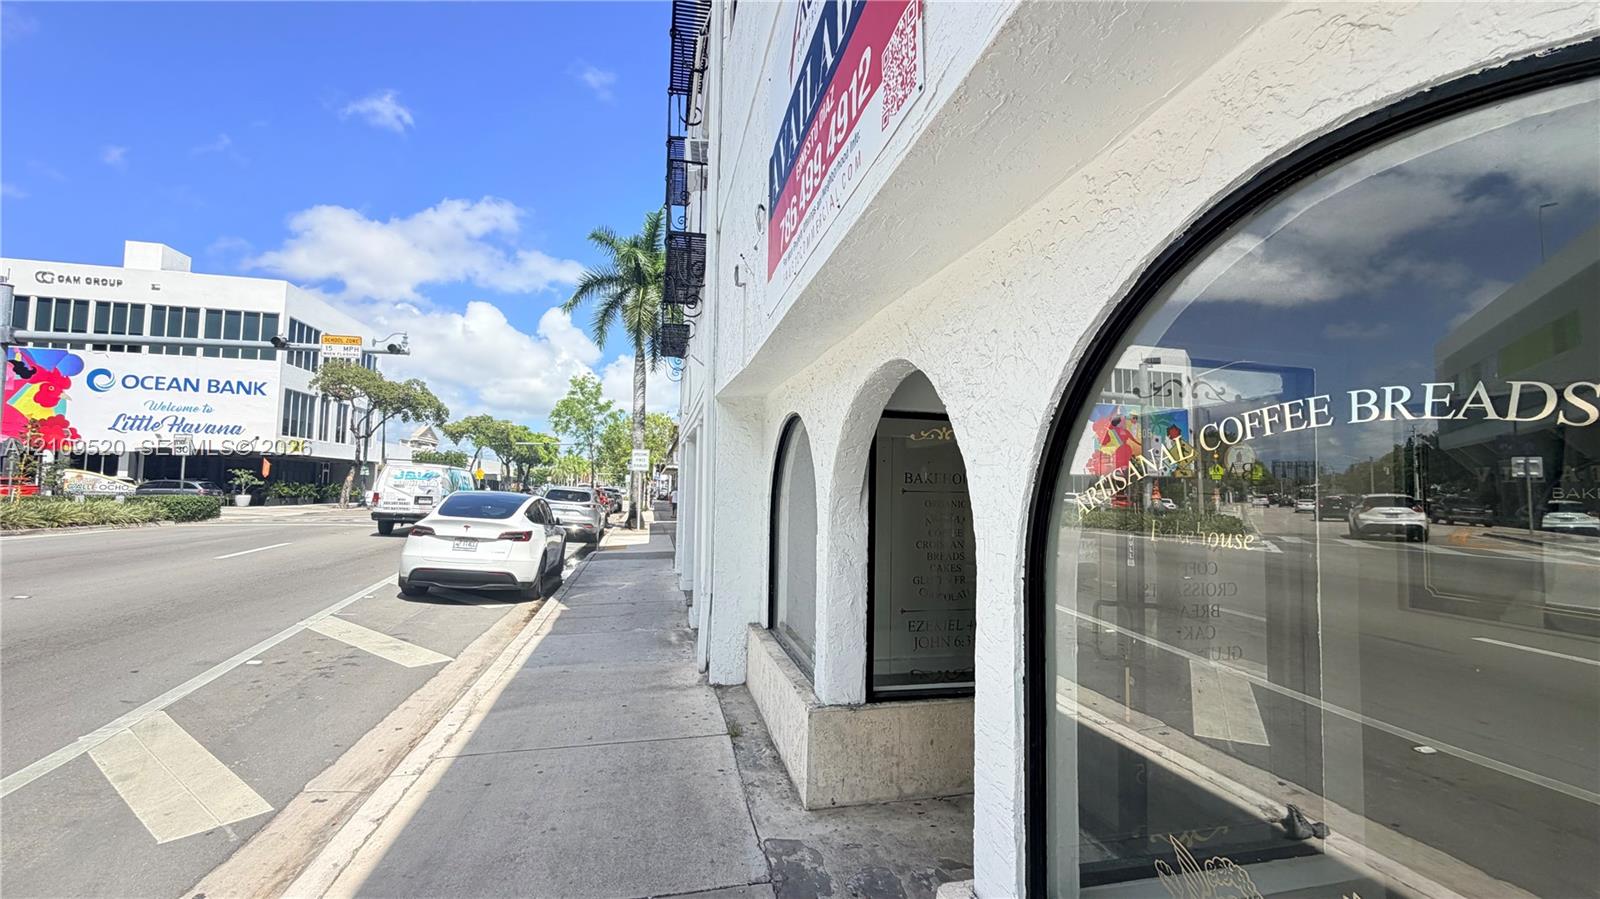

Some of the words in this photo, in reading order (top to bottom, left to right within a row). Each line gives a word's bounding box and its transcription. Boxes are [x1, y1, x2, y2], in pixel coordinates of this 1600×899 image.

[771, 0, 859, 202] AVAILAB
[85, 277, 123, 287] GROUP
[121, 374, 200, 393] OCEAN
[207, 379, 267, 396] BANK
[144, 400, 199, 413] Welcome
[202, 403, 215, 414] to
[108, 413, 161, 434] Little
[161, 415, 246, 435] Havana
[1075, 435, 1195, 521] ARTISANAL
[1200, 394, 1335, 452] COFFEE
[1346, 380, 1600, 427] BREADS
